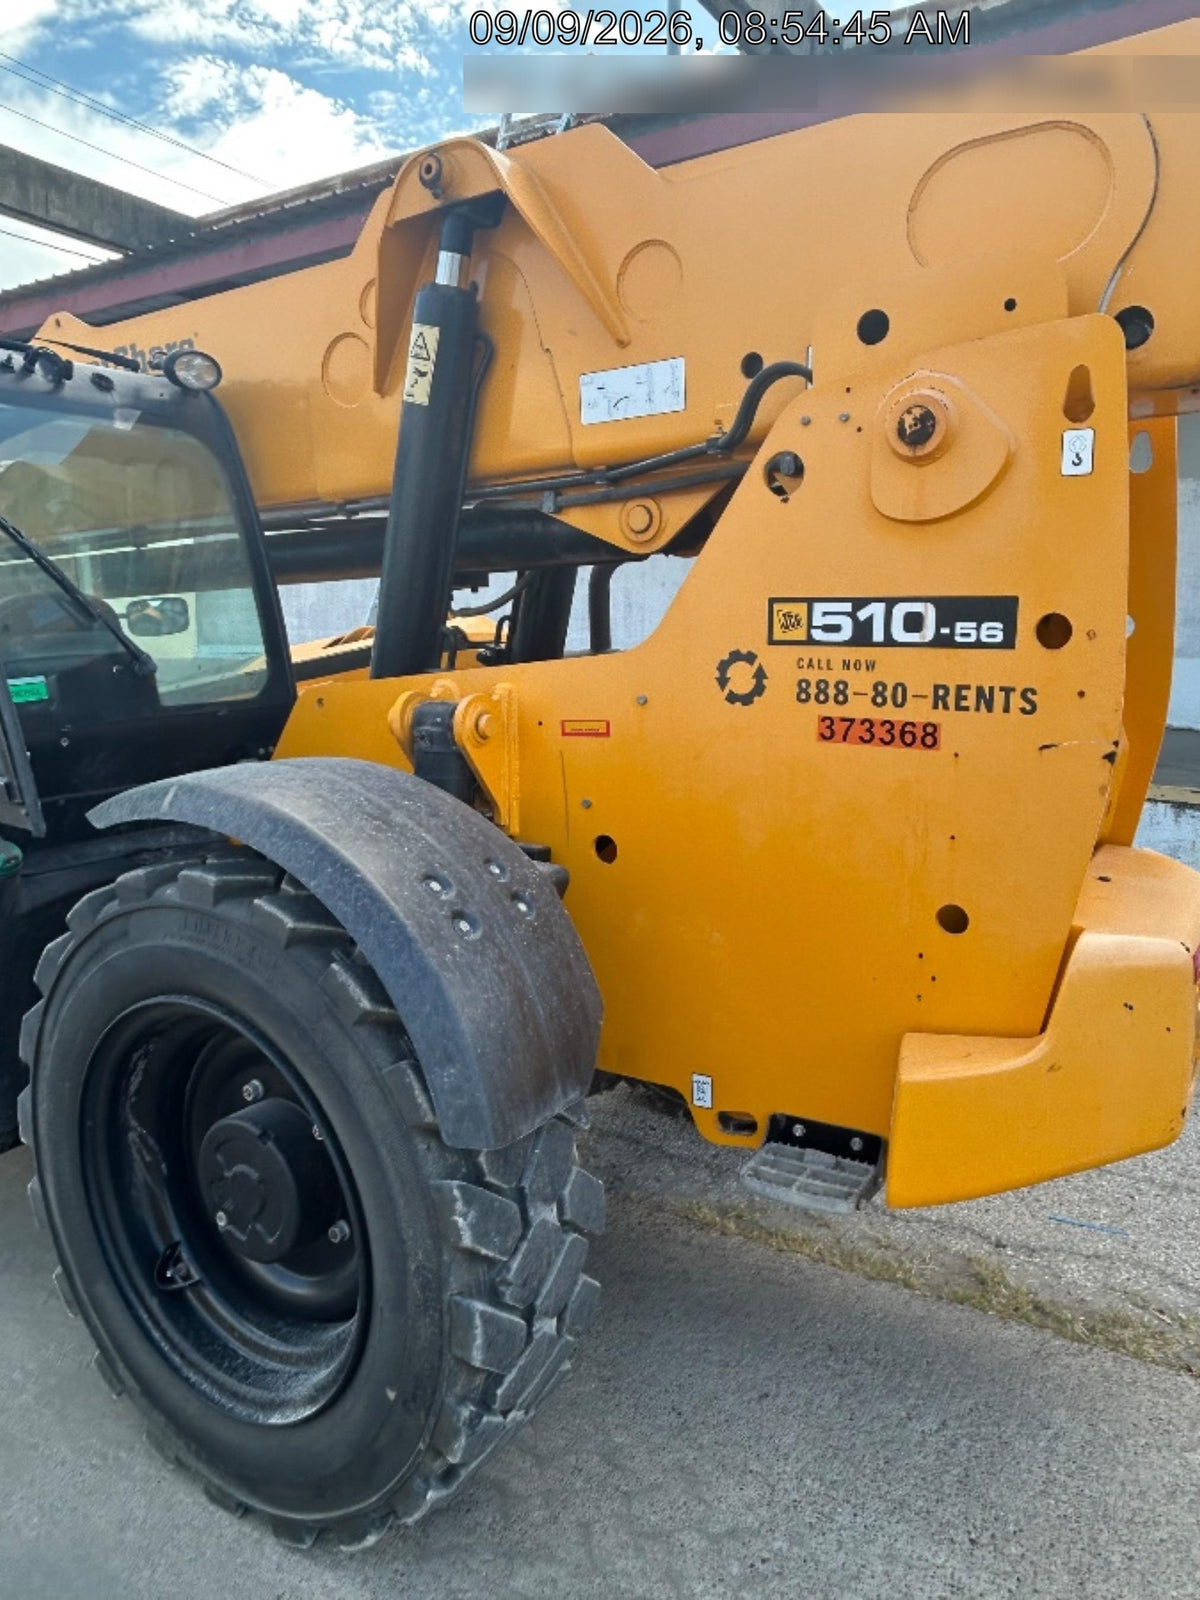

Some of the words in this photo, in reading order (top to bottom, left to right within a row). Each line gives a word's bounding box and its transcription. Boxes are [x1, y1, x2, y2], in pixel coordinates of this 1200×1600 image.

[810, 601, 1004, 643] 510-56
[796, 657, 834, 671] CALL
[842, 659, 877, 672] NOW
[796, 678, 1038, 715] 888-80-RENTS
[819, 716, 938, 749] 373368
